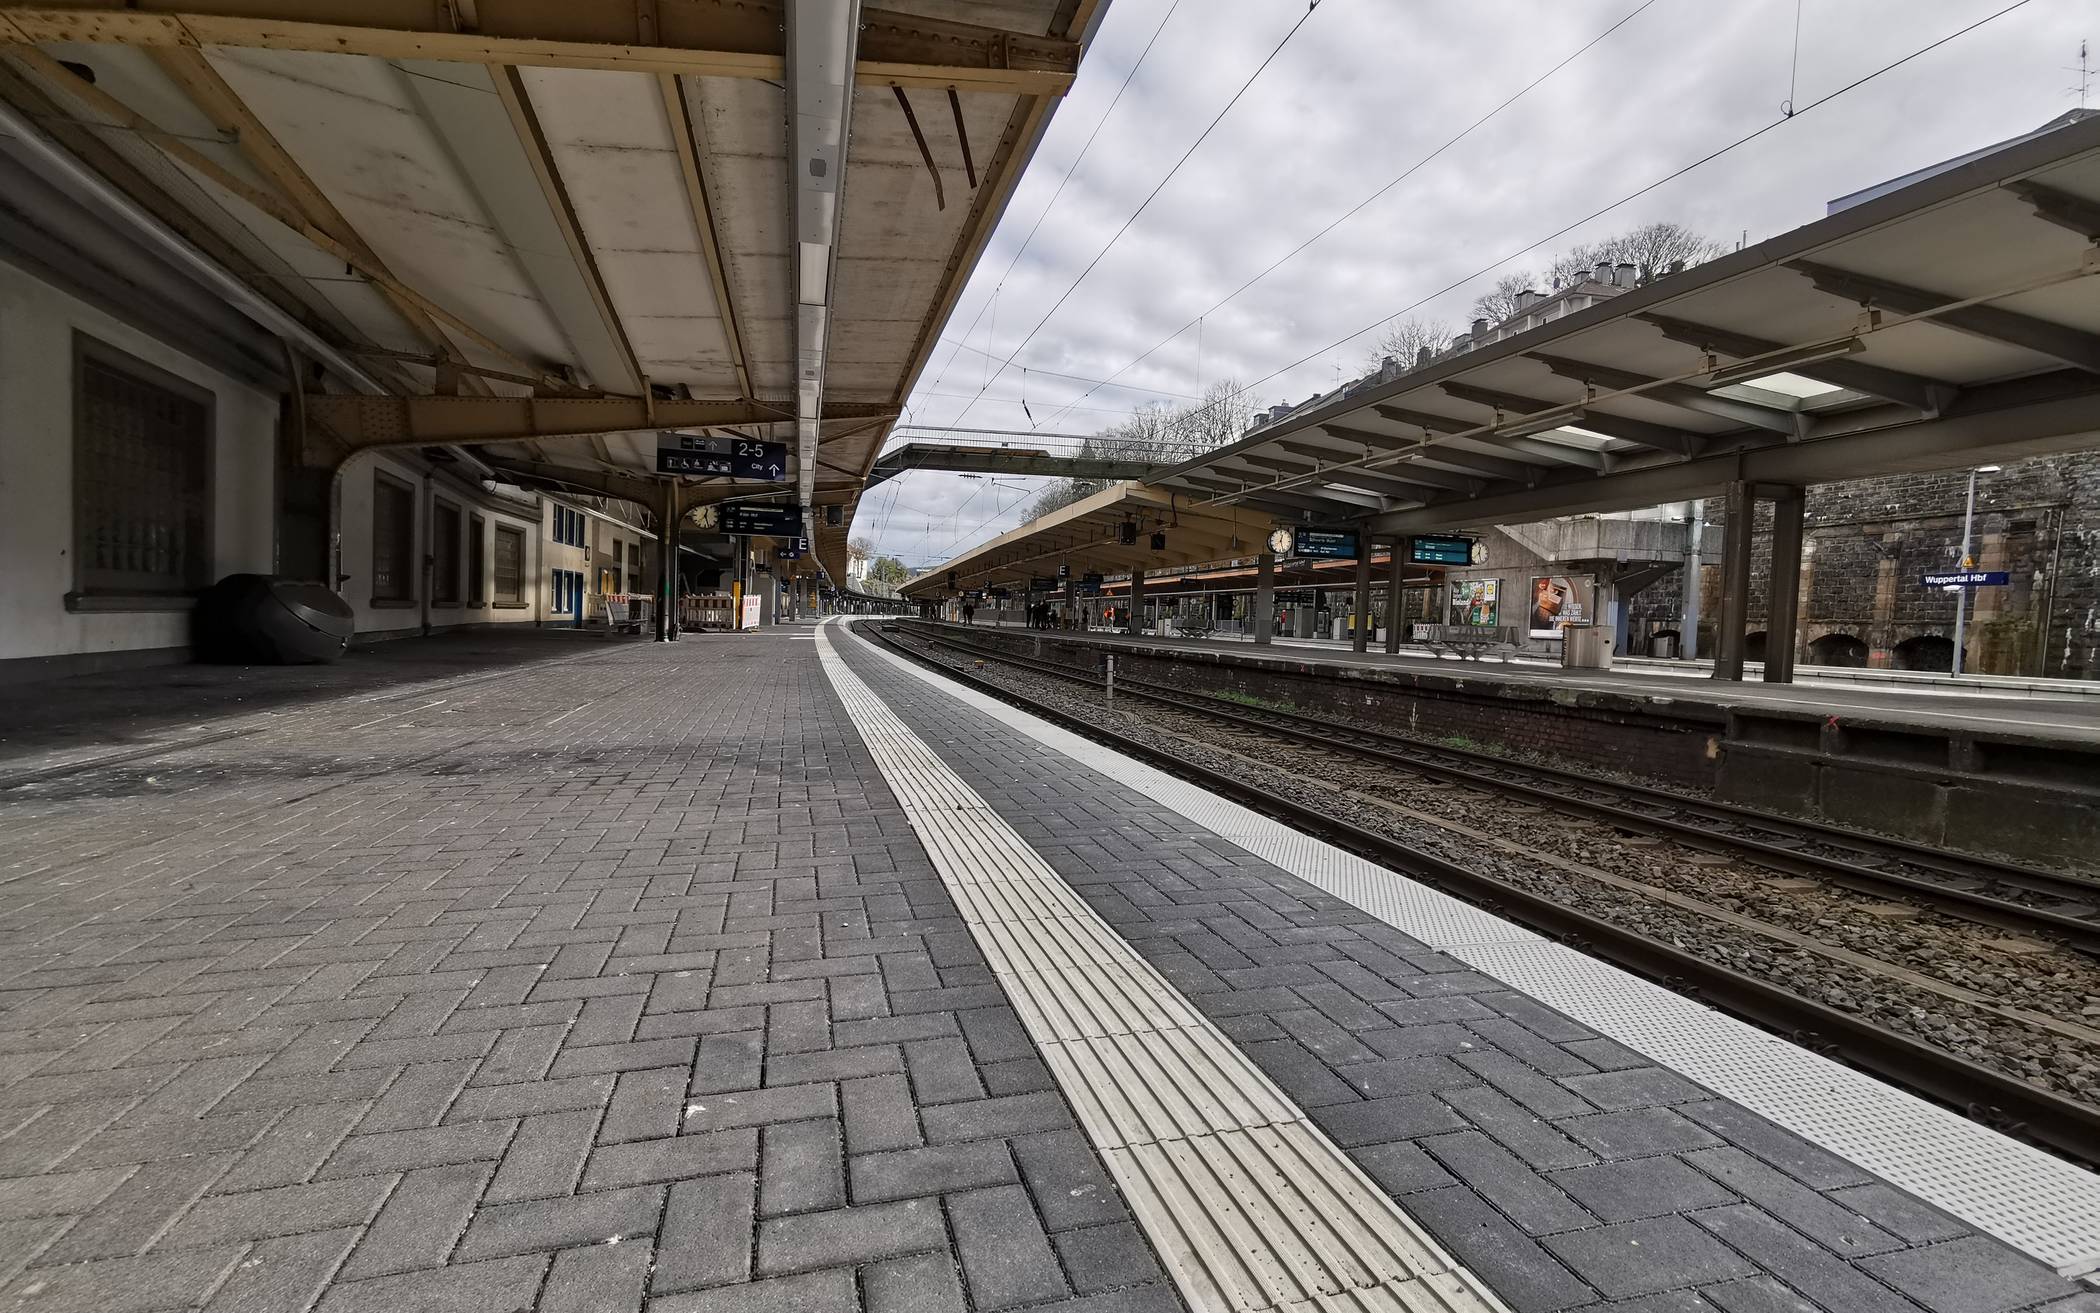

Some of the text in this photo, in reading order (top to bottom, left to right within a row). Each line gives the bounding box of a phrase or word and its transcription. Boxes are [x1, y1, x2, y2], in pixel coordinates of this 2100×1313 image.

[739, 442, 764, 458] 2-5
[751, 463, 763, 471] City
[799, 538, 807, 550] E
[1059, 565, 1066, 576] E
[1925, 573, 1987, 584] Wuppertal Hbf
